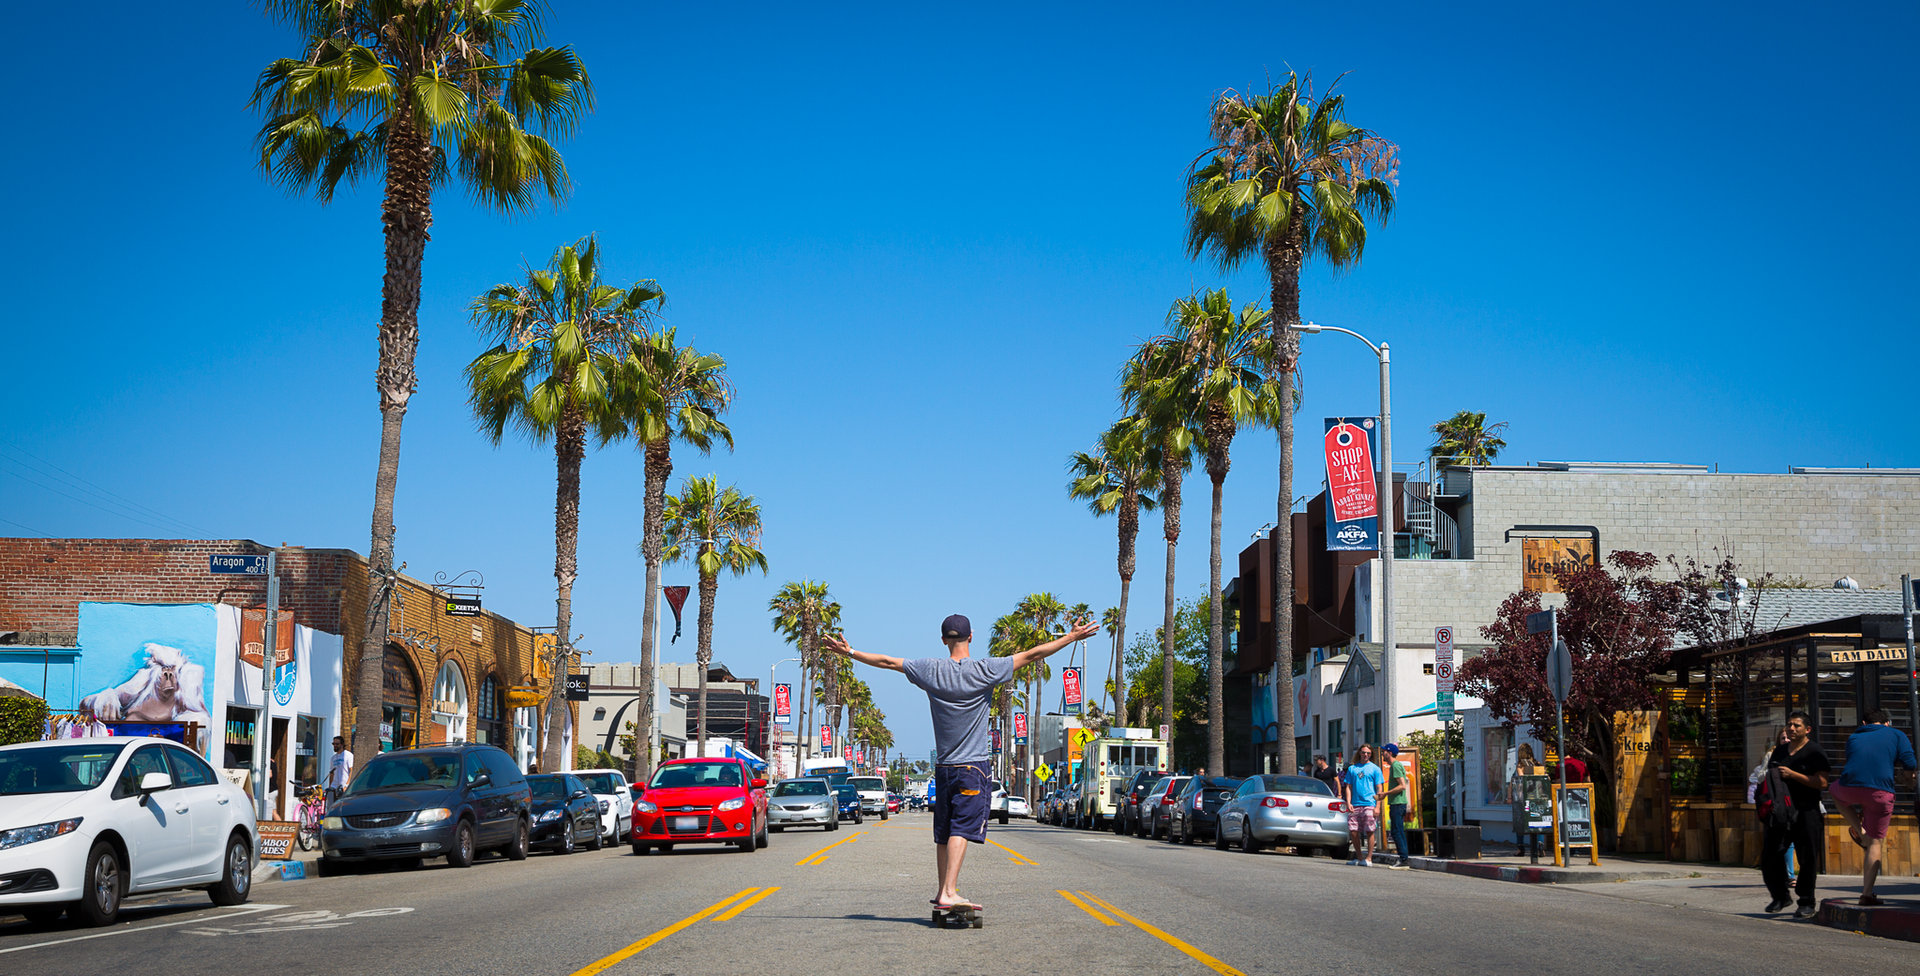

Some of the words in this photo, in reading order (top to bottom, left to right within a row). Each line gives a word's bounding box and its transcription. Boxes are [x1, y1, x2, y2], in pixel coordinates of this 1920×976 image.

[1331, 447, 1364, 467] SHOP
[1336, 530, 1368, 539] AKFA
[212, 556, 244, 569] Aragon
[255, 556, 266, 567] Ct
[456, 604, 480, 612] KEETSA
[248, 643, 263, 655] TOPO
[1866, 648, 1907, 661] DAILY
[226, 720, 254, 746] HOLA
[256, 825, 296, 833] ENJEES
[261, 839, 290, 848] MBOO
[260, 847, 286, 855] ADES
